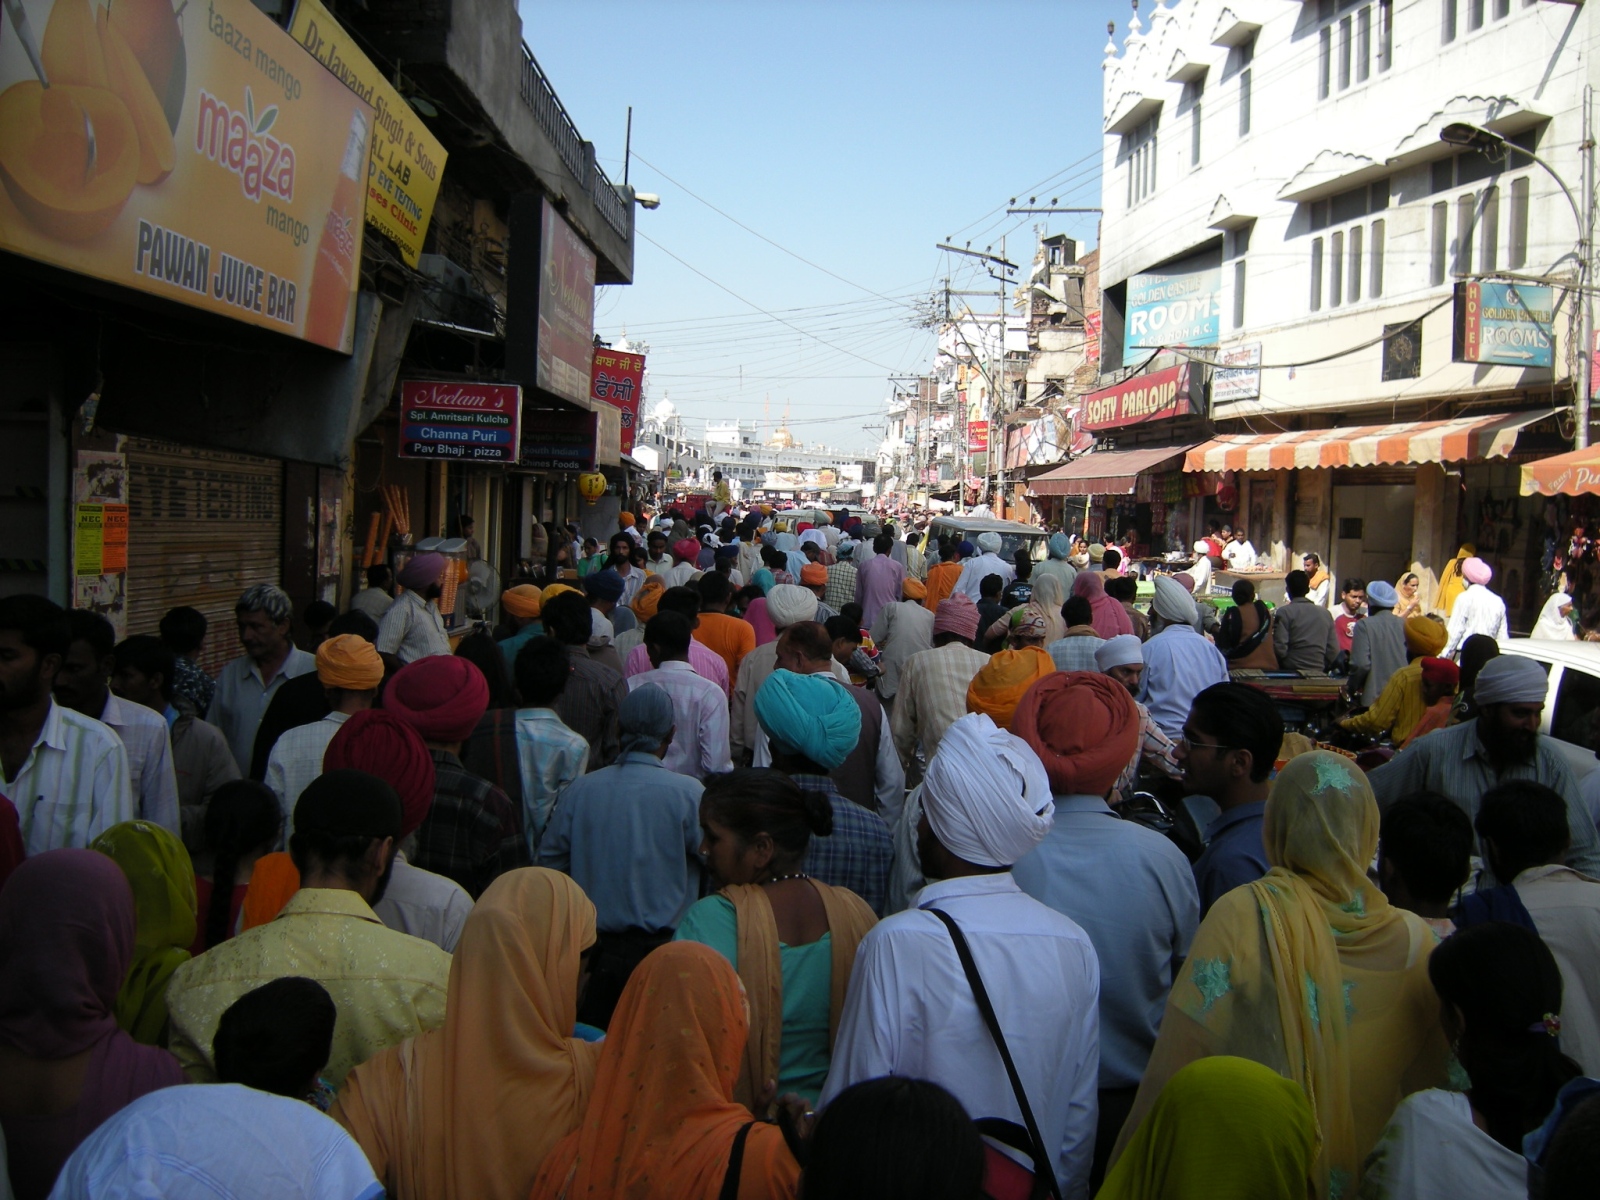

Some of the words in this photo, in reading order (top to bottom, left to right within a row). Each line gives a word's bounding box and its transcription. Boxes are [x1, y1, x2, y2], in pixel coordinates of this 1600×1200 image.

[208, 0, 252, 62] taaza
[255, 47, 301, 100] mango
[196, 90, 295, 203] maaza
[374, 95, 405, 145] Singh
[414, 142, 437, 182] Sons
[377, 170, 394, 194] EYE
[387, 150, 411, 187] LAB
[266, 204, 309, 247] mango
[390, 203, 418, 237] Clinic
[136, 219, 211, 295] PAWAN
[213, 253, 264, 313] JUICE
[266, 273, 297, 325] BAR
[1131, 286, 1166, 309] GOLDEN
[1167, 277, 1202, 299] CASTLE
[1468, 286, 1477, 359] HOTEL
[1482, 307, 1518, 322] GOLDEN
[1517, 308, 1550, 324] CASTLE
[1167, 329, 1190, 342] NON
[1193, 322, 1213, 336] A.C.
[1481, 326, 1550, 349] ROOMS
[1087, 396, 1117, 425] SOFTY
[1121, 380, 1177, 419] PARLOUR
[410, 410, 428, 421] Spl.
[430, 411, 474, 422] Amritsari
[476, 413, 509, 424] Kulcha
[420, 427, 468, 440] Channa
[472, 430, 497, 442] Puri
[414, 443, 434, 453] Pav
[437, 444, 465, 457] Bhaji
[474, 446, 502, 457] pizza
[520, 459, 551, 468] Chines
[552, 460, 579, 469] Foods
[523, 446, 550, 455] South
[551, 446, 579, 456] Indian
[1547, 467, 1572, 491] Fancy
